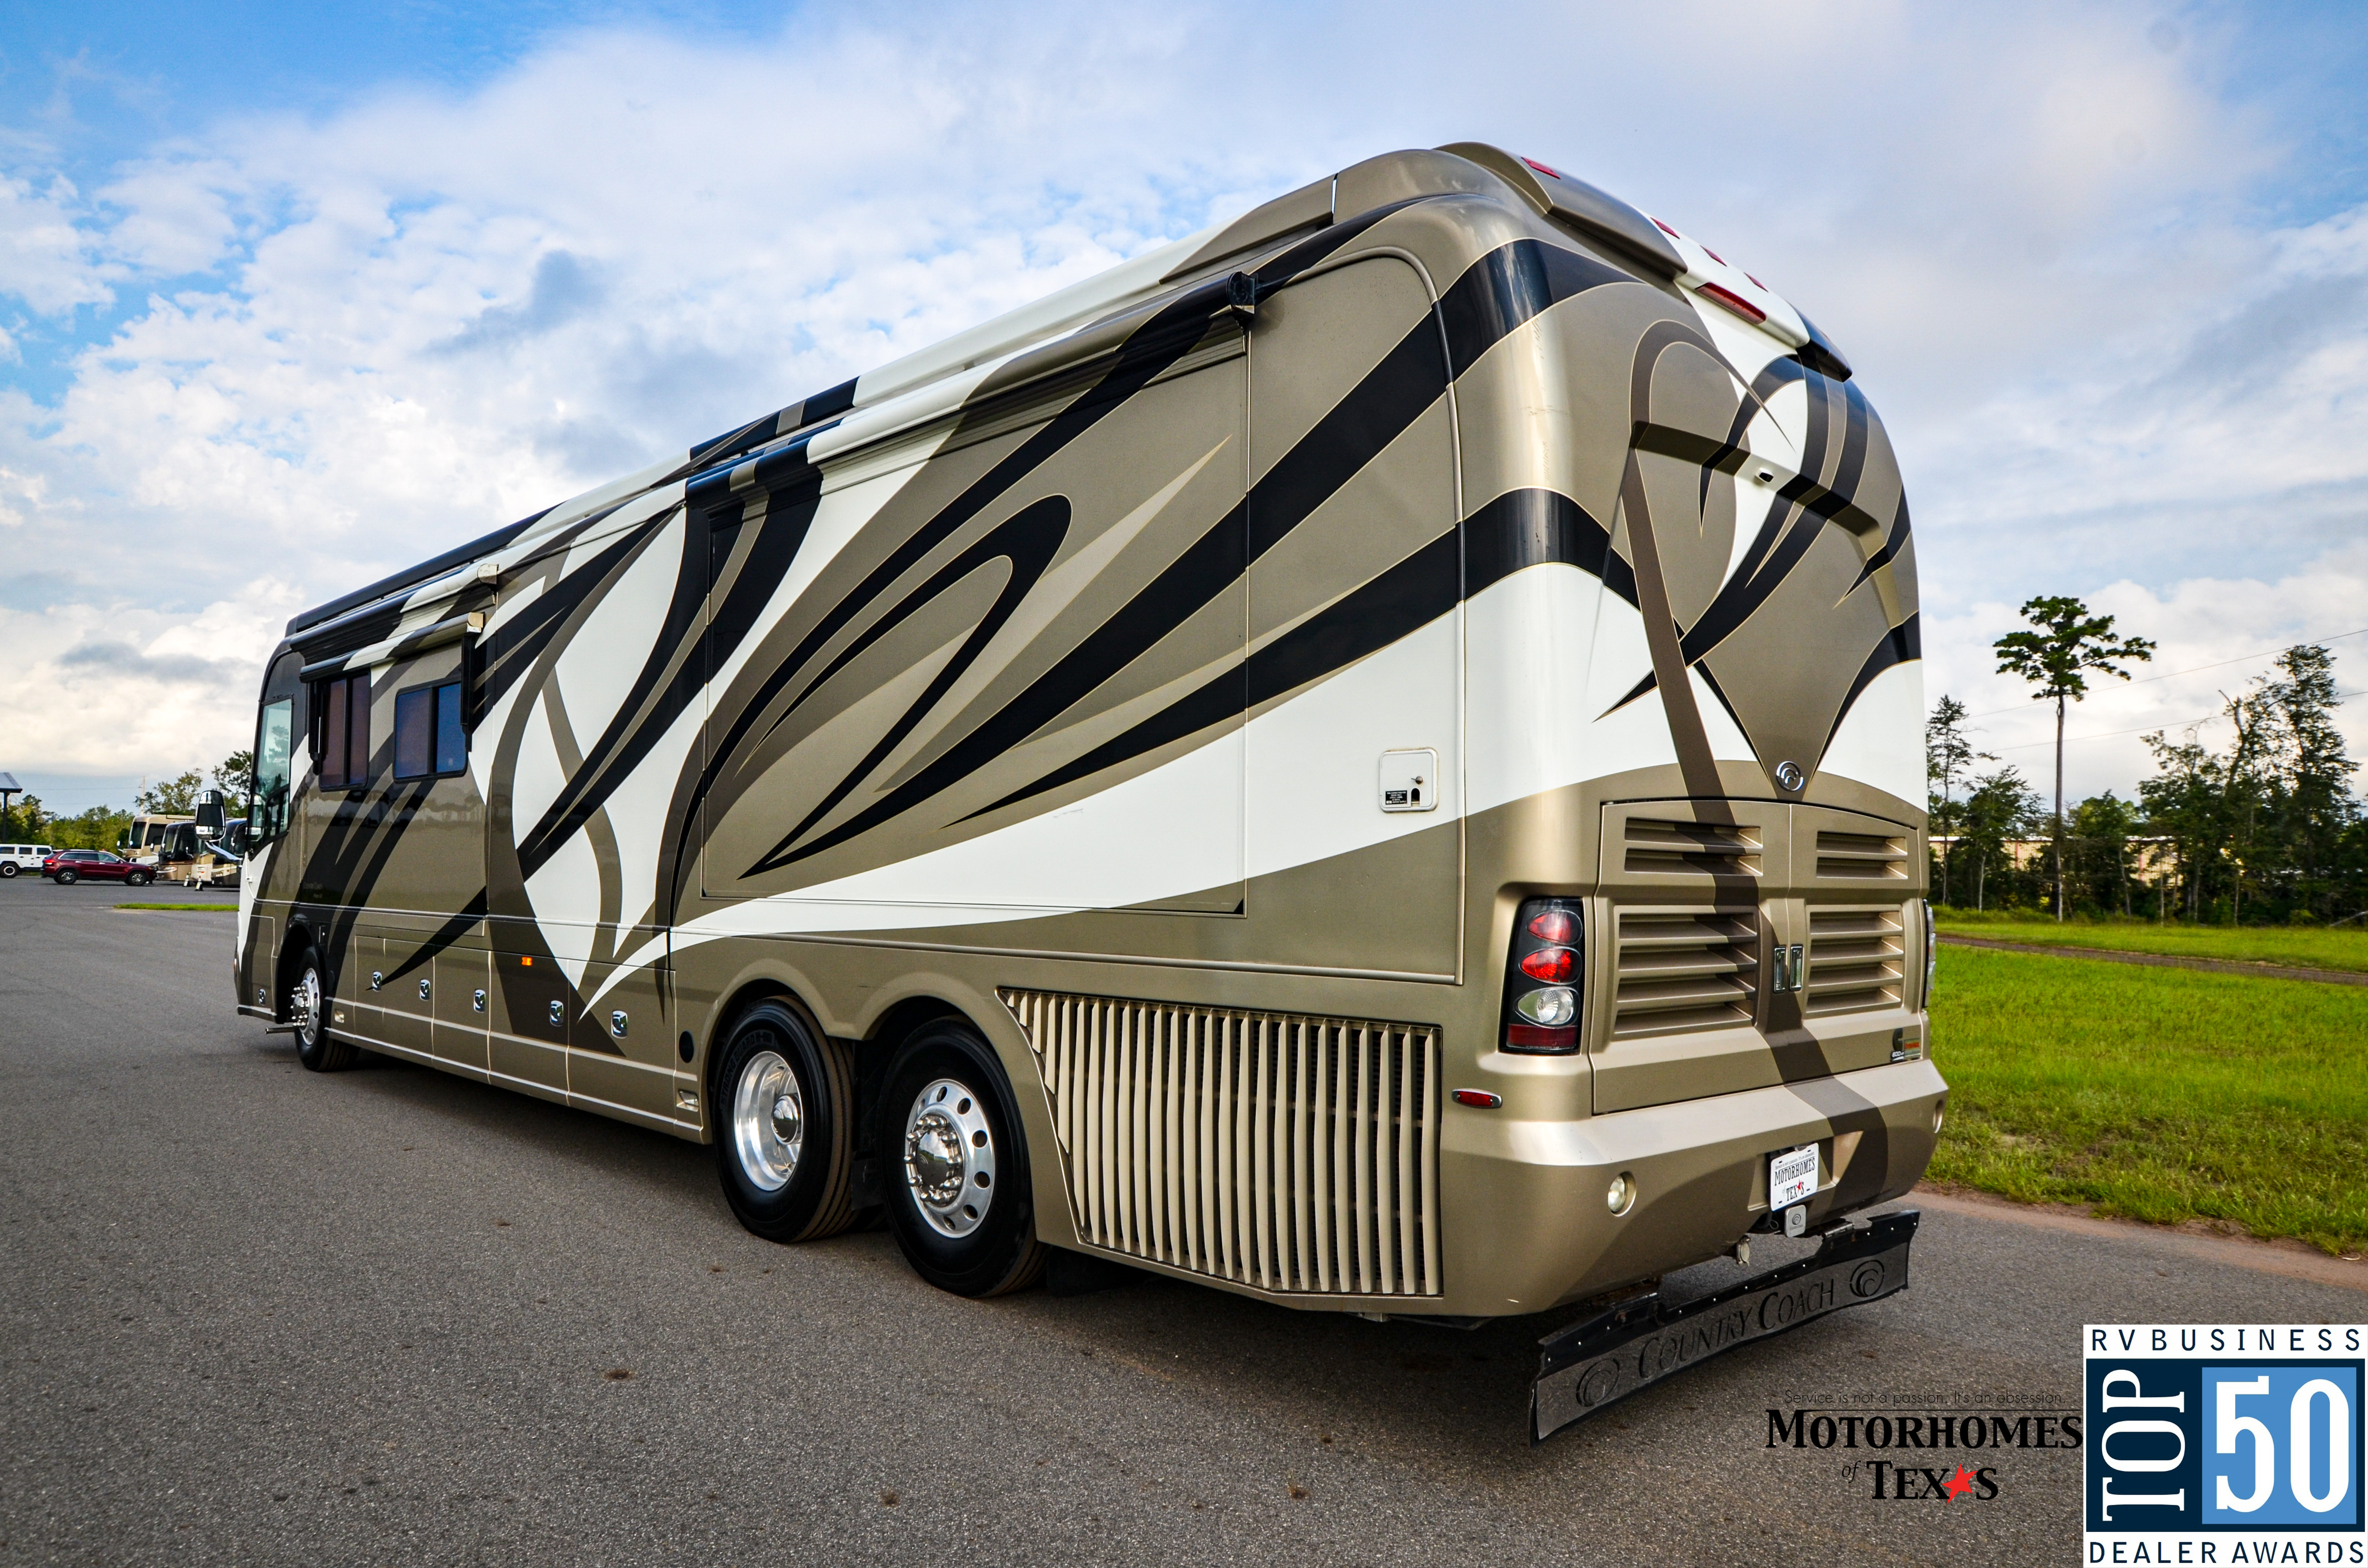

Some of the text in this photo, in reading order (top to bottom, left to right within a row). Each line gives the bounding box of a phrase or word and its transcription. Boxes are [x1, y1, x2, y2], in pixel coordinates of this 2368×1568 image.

[734, 1034, 756, 1061] GUARD
[1774, 1157, 1815, 1186] MOTORHOMES
[1786, 1181, 1805, 1201] TEXS
[1638, 1279, 1834, 1378] COUNTRY COACH
